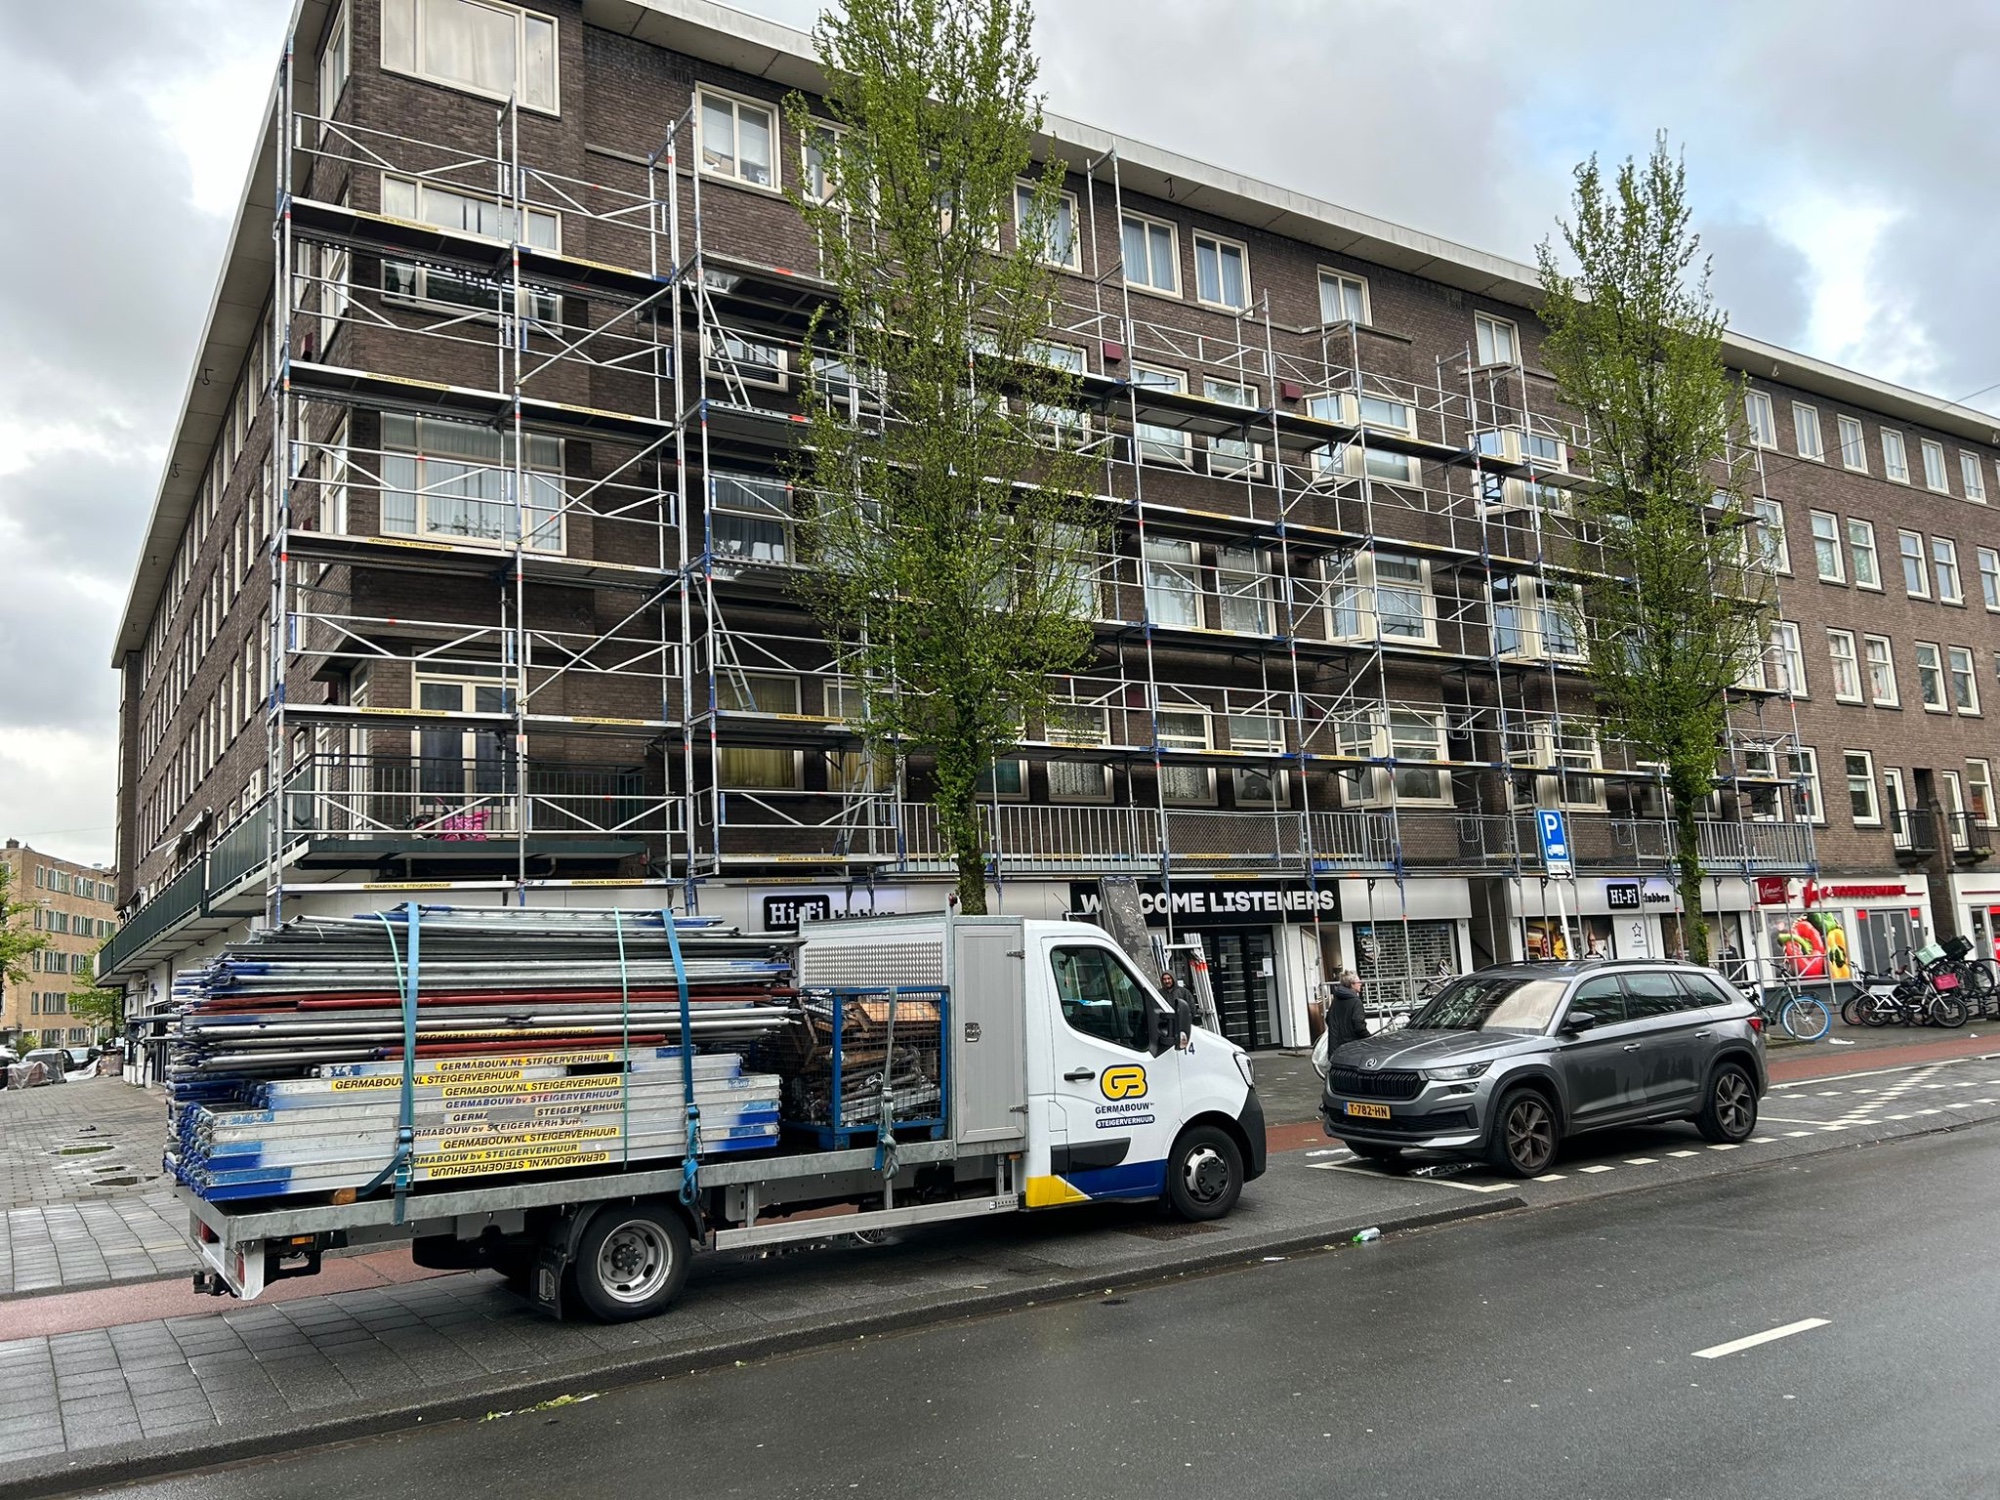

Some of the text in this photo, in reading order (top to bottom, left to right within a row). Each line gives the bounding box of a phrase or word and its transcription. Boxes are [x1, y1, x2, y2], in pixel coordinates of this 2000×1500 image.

[1544, 814, 1558, 839] P
[1080, 890, 1334, 914] WCOME LISTENERS
[1610, 889, 1638, 904] Hi-Fi
[441, 1058, 523, 1071] GERMABOUW.NL
[335, 1071, 520, 1089] GERMABOUNL STEIGERVERHUUR
[445, 1077, 618, 1096] GERMABOUW.NL STEIGERVERHUUR
[446, 1096, 515, 1109] GERMABOUW
[537, 1102, 626, 1116] STEIGERVERHUUR
[1095, 1102, 1150, 1114] GERMABOUW
[1350, 1104, 1387, 1117] T-782-HN
[1096, 1115, 1155, 1128] STEIGERVERHUUR
[414, 1126, 471, 1138] RMABOUW
[443, 1127, 617, 1149] GERMABOUW.NL STEIGERVERHUUR
[413, 1153, 469, 1165] RMABOUW
[485, 1144, 578, 1158] STEIGERVERHUUR
[431, 1152, 606, 1177] GERMABOUW.NL STEIGERVERHUUR
